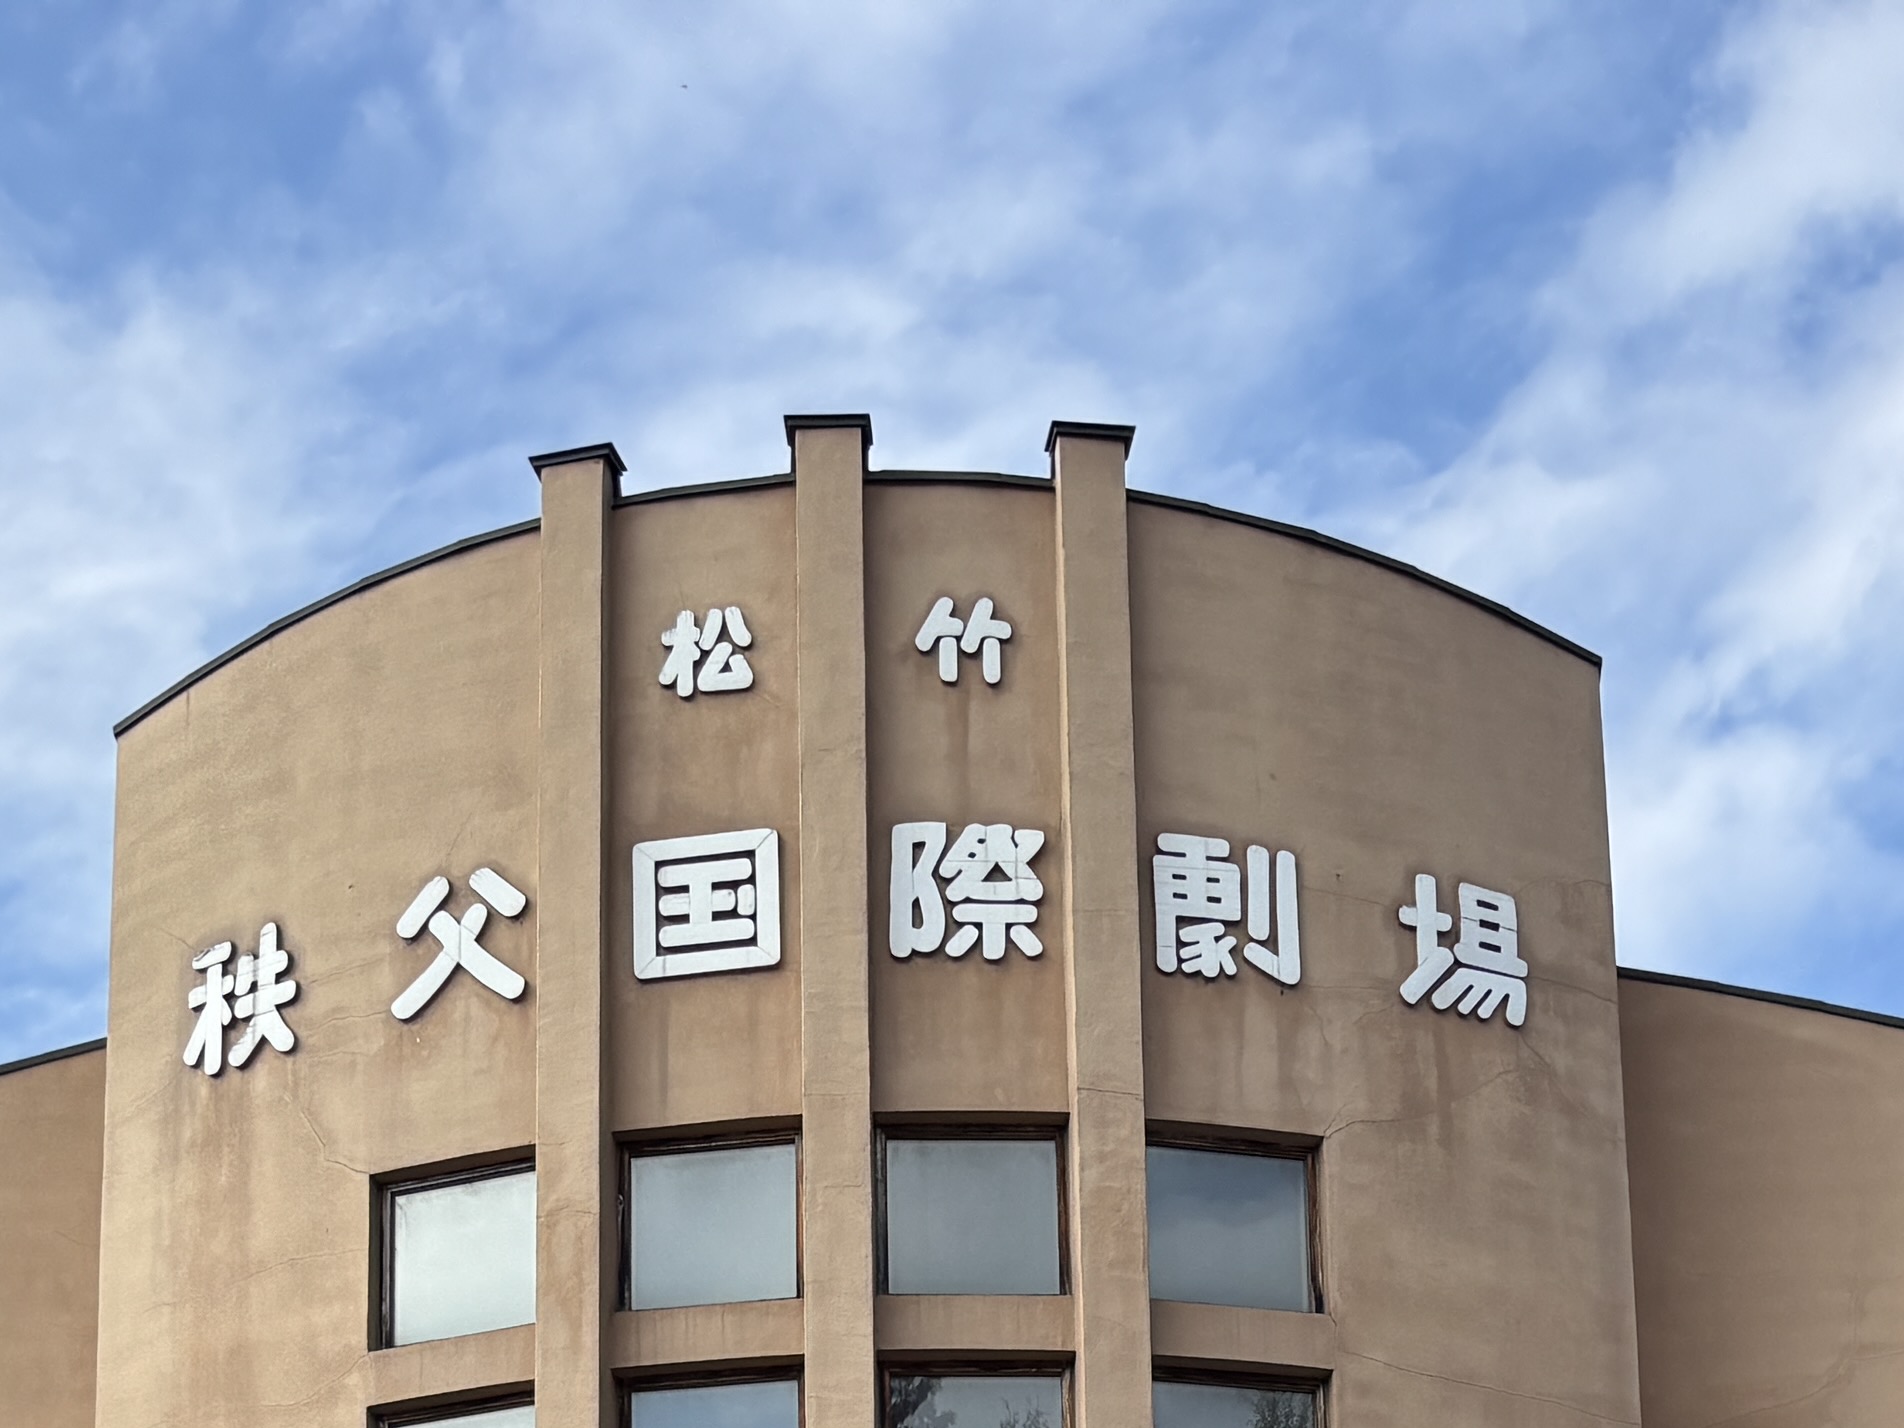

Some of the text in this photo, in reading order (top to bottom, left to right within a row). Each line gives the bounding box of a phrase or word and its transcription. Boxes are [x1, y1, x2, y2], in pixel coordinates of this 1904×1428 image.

[659, 596, 1011, 699] 松竹
[183, 822, 1529, 1076] 秩父国際劇場
